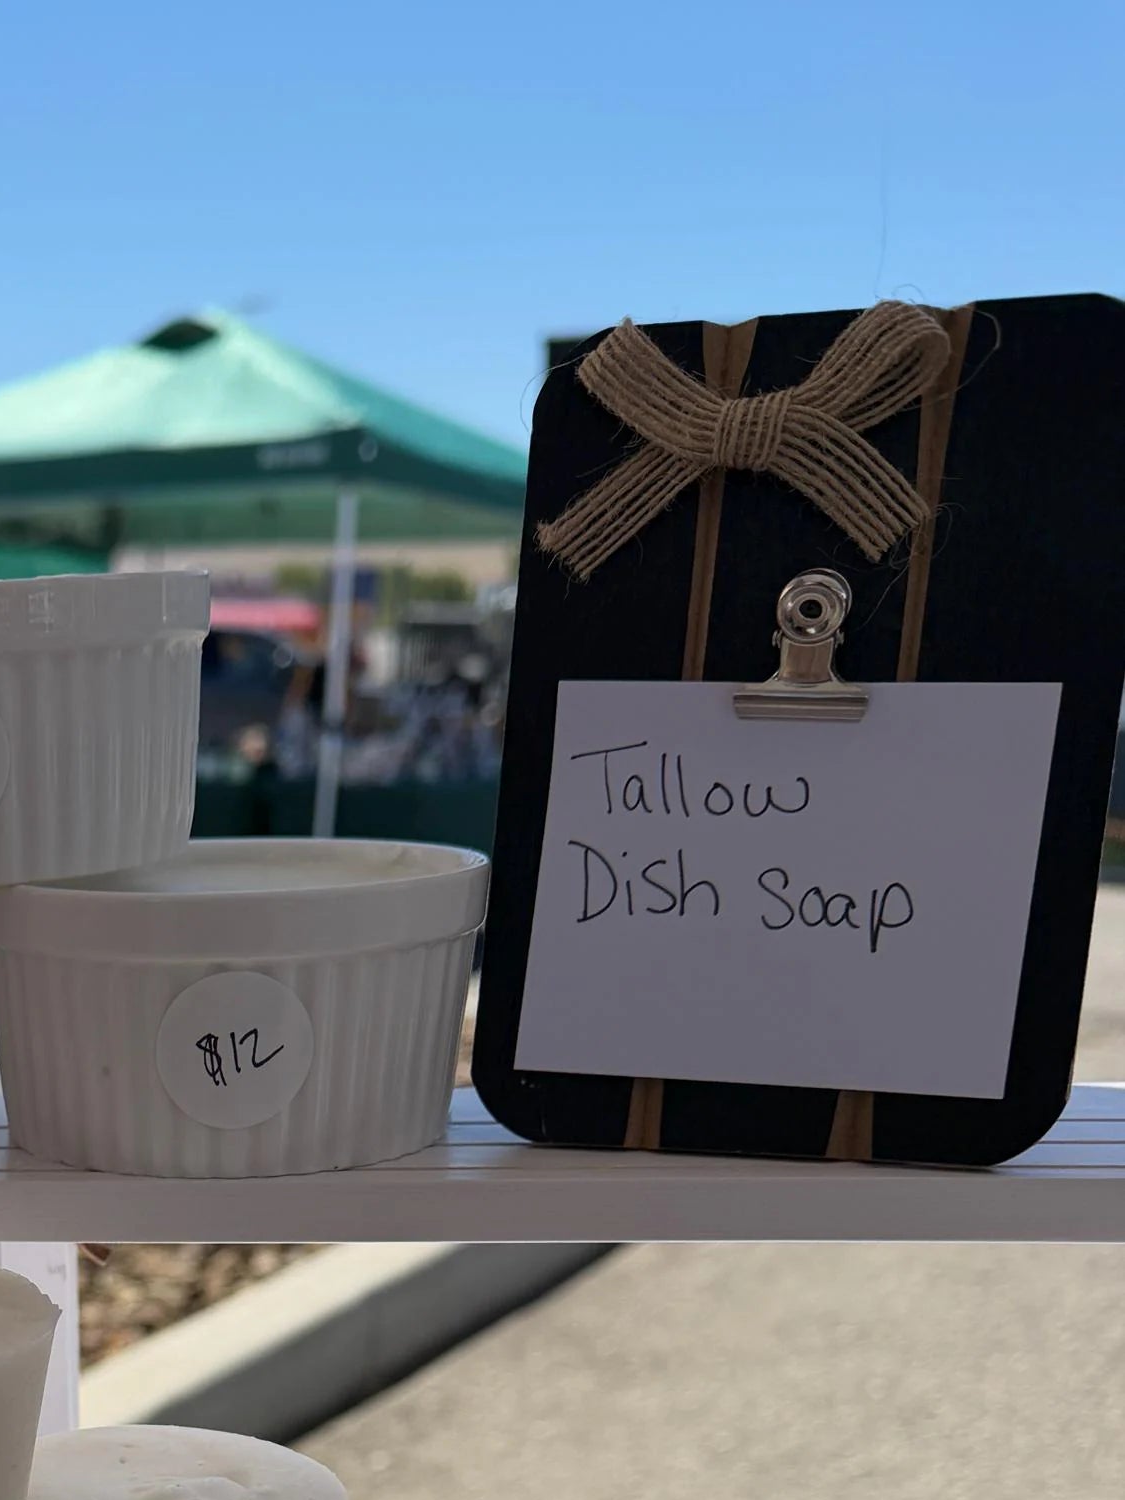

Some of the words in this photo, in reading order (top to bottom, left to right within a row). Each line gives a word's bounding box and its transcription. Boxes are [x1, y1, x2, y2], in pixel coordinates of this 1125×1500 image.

[570, 740, 811, 818] Tallow
[568, 839, 721, 924] Dish
[757, 867, 915, 954] Soap
[194, 1027, 286, 1087] $12
